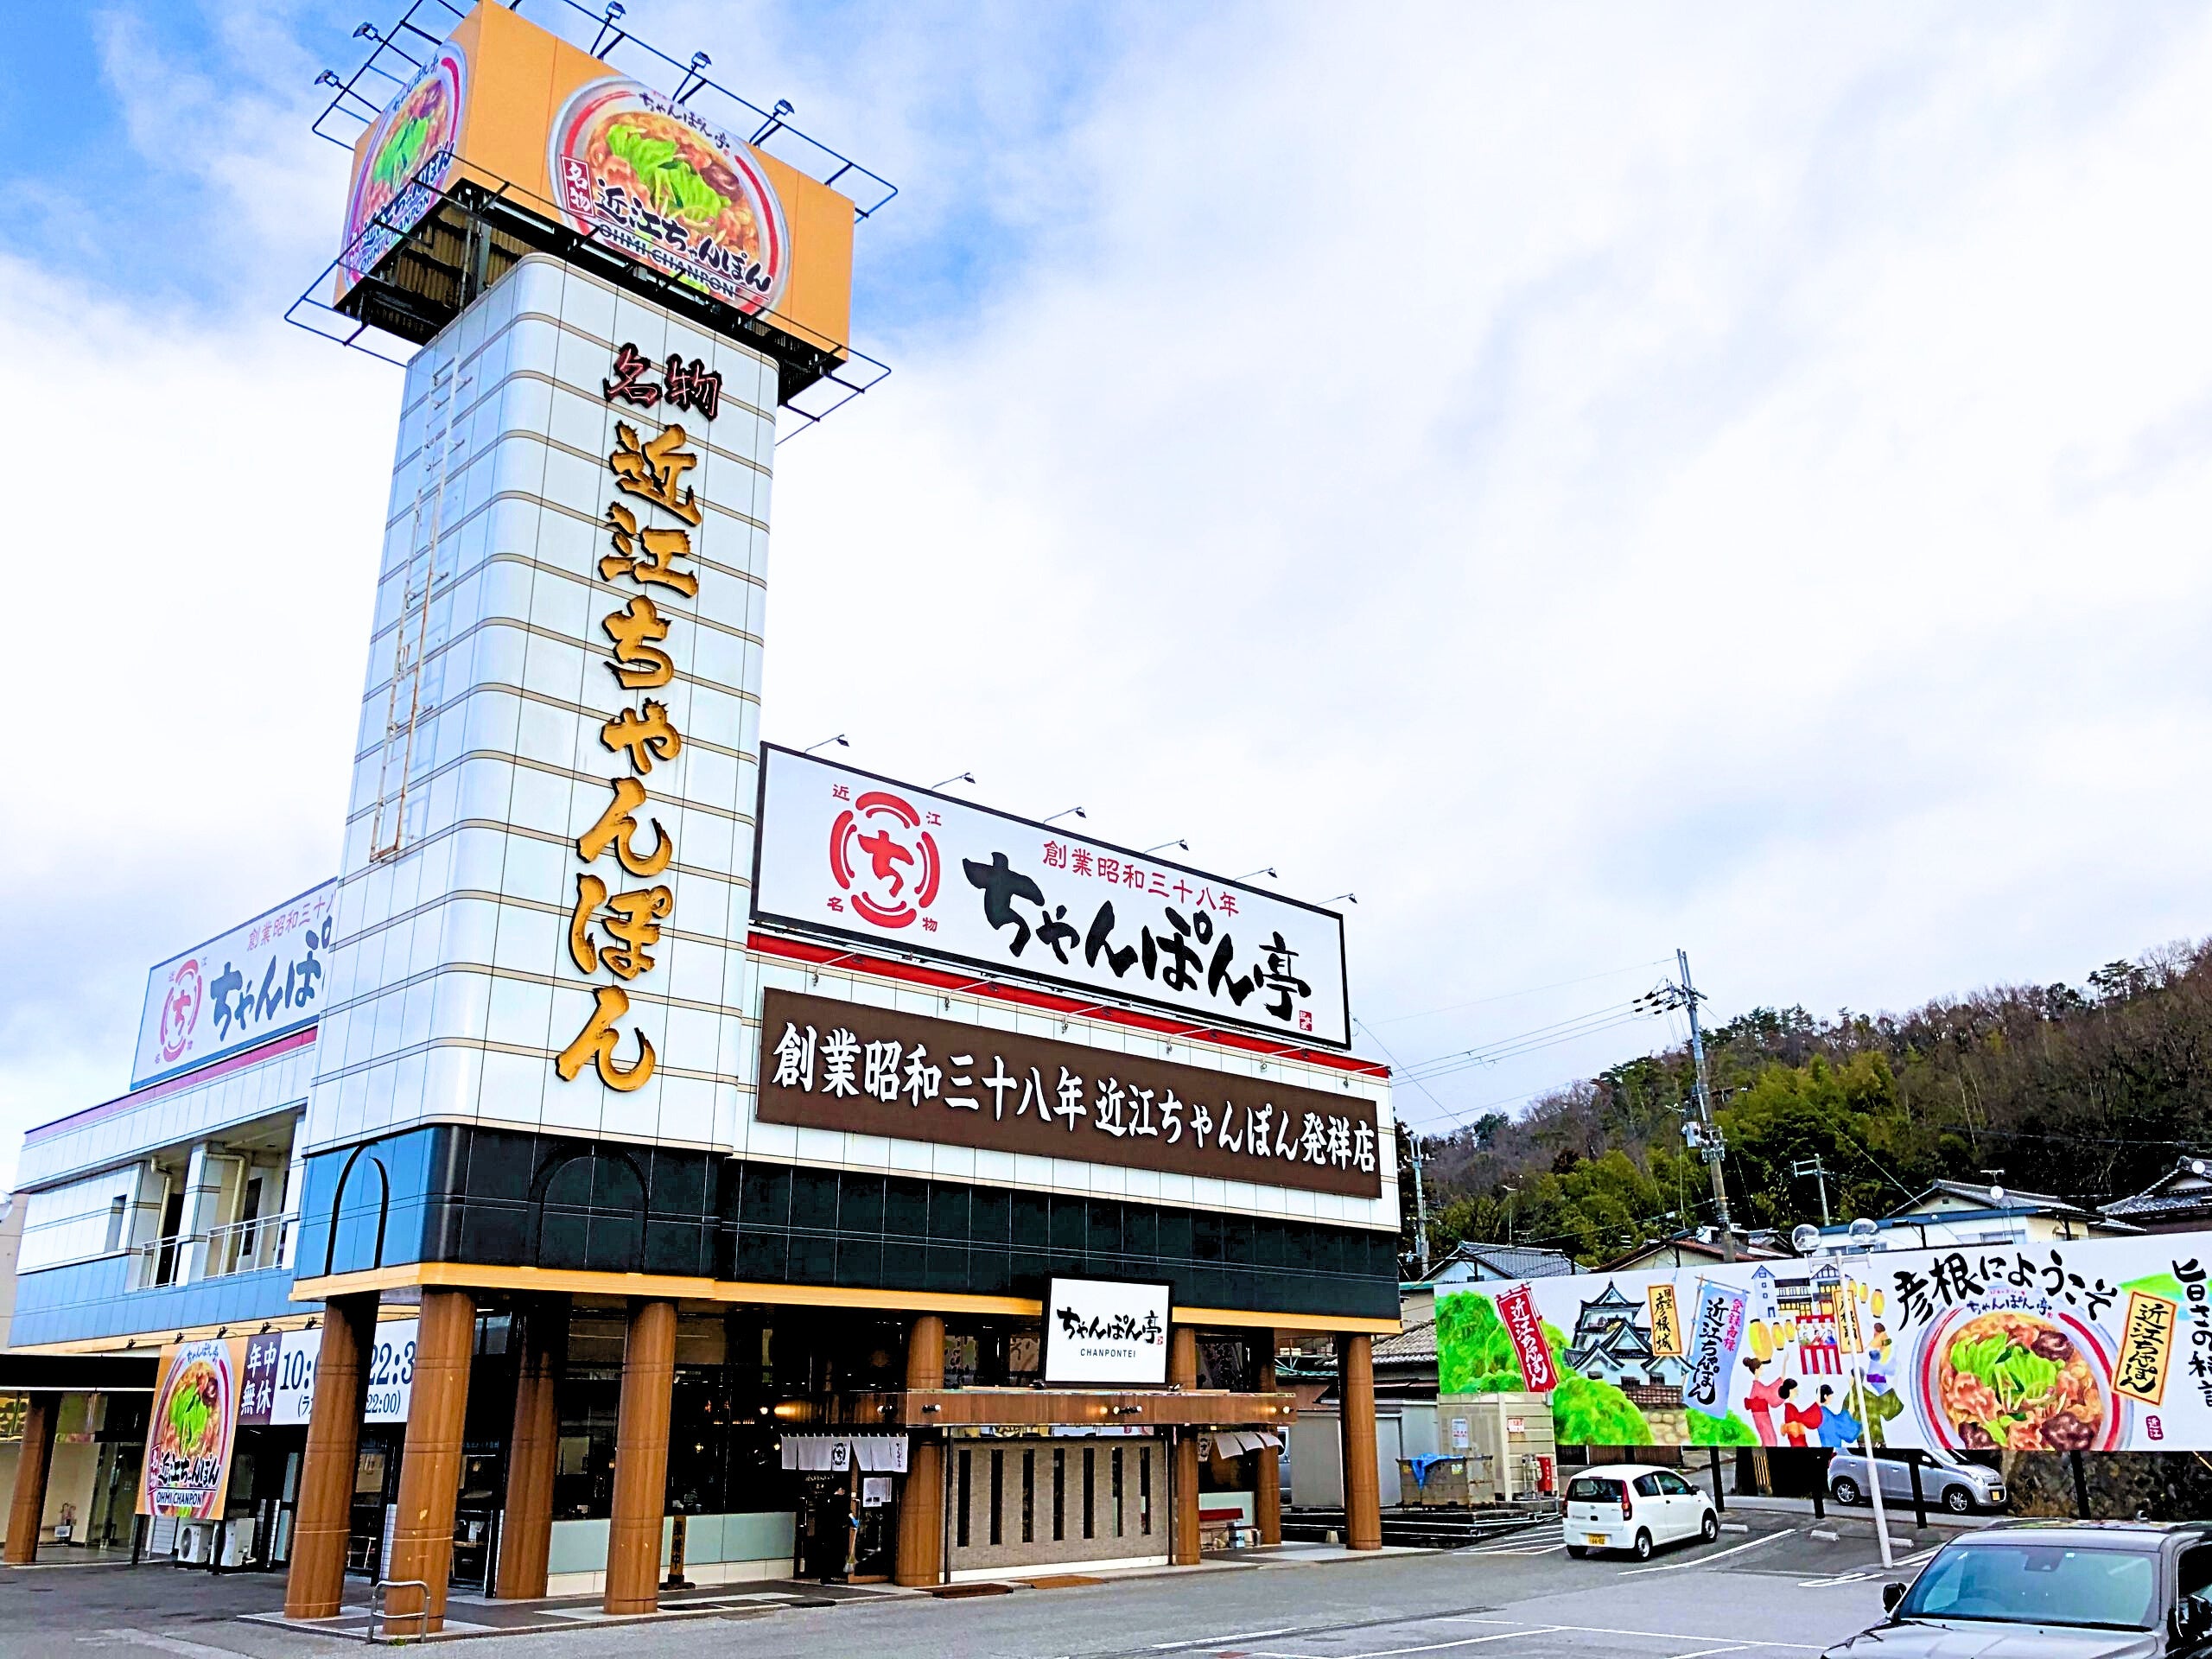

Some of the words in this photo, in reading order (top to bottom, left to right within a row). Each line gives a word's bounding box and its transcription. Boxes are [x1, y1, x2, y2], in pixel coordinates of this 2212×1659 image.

[639, 92, 730, 150] ちゃんぽん亭
[567, 162, 591, 212] 名物
[594, 178, 771, 292] 近江ちゃんぽん
[600, 223, 646, 257] OHMI
[652, 247, 735, 298] CHANPON
[603, 342, 722, 421] 名物
[556, 420, 702, 1093] 近江ちゃんぽん
[832, 784, 850, 801] 近
[925, 810, 942, 827] 江
[827, 896, 843, 912] 名
[1042, 841, 1240, 917] 創業昭和三十八年
[922, 917, 938, 932] 物
[962, 852, 1313, 1021] ちゃんぽん亭
[210, 915, 333, 1042] ちゃんぽ
[772, 1021, 1088, 1132] 創業昭和三十八年
[1093, 1077, 1376, 1174] 近江ちゃんぽん発祥店
[1893, 1249, 2119, 1332] 彦根にようこそ
[1057, 1306, 1162, 1344] ちゃんぽん亭
[1080, 1348, 1136, 1357] CHANPONTEI
[1688, 1297, 1730, 1406] 近江ちゃんぽん
[2120, 1303, 2170, 1394] 近江ちゃんぽん
[247, 1342, 277, 1379] 年中
[279, 1350, 321, 1390] 10:
[241, 1380, 272, 1416] 無休
[172, 1491, 202, 1506] CHANPON
